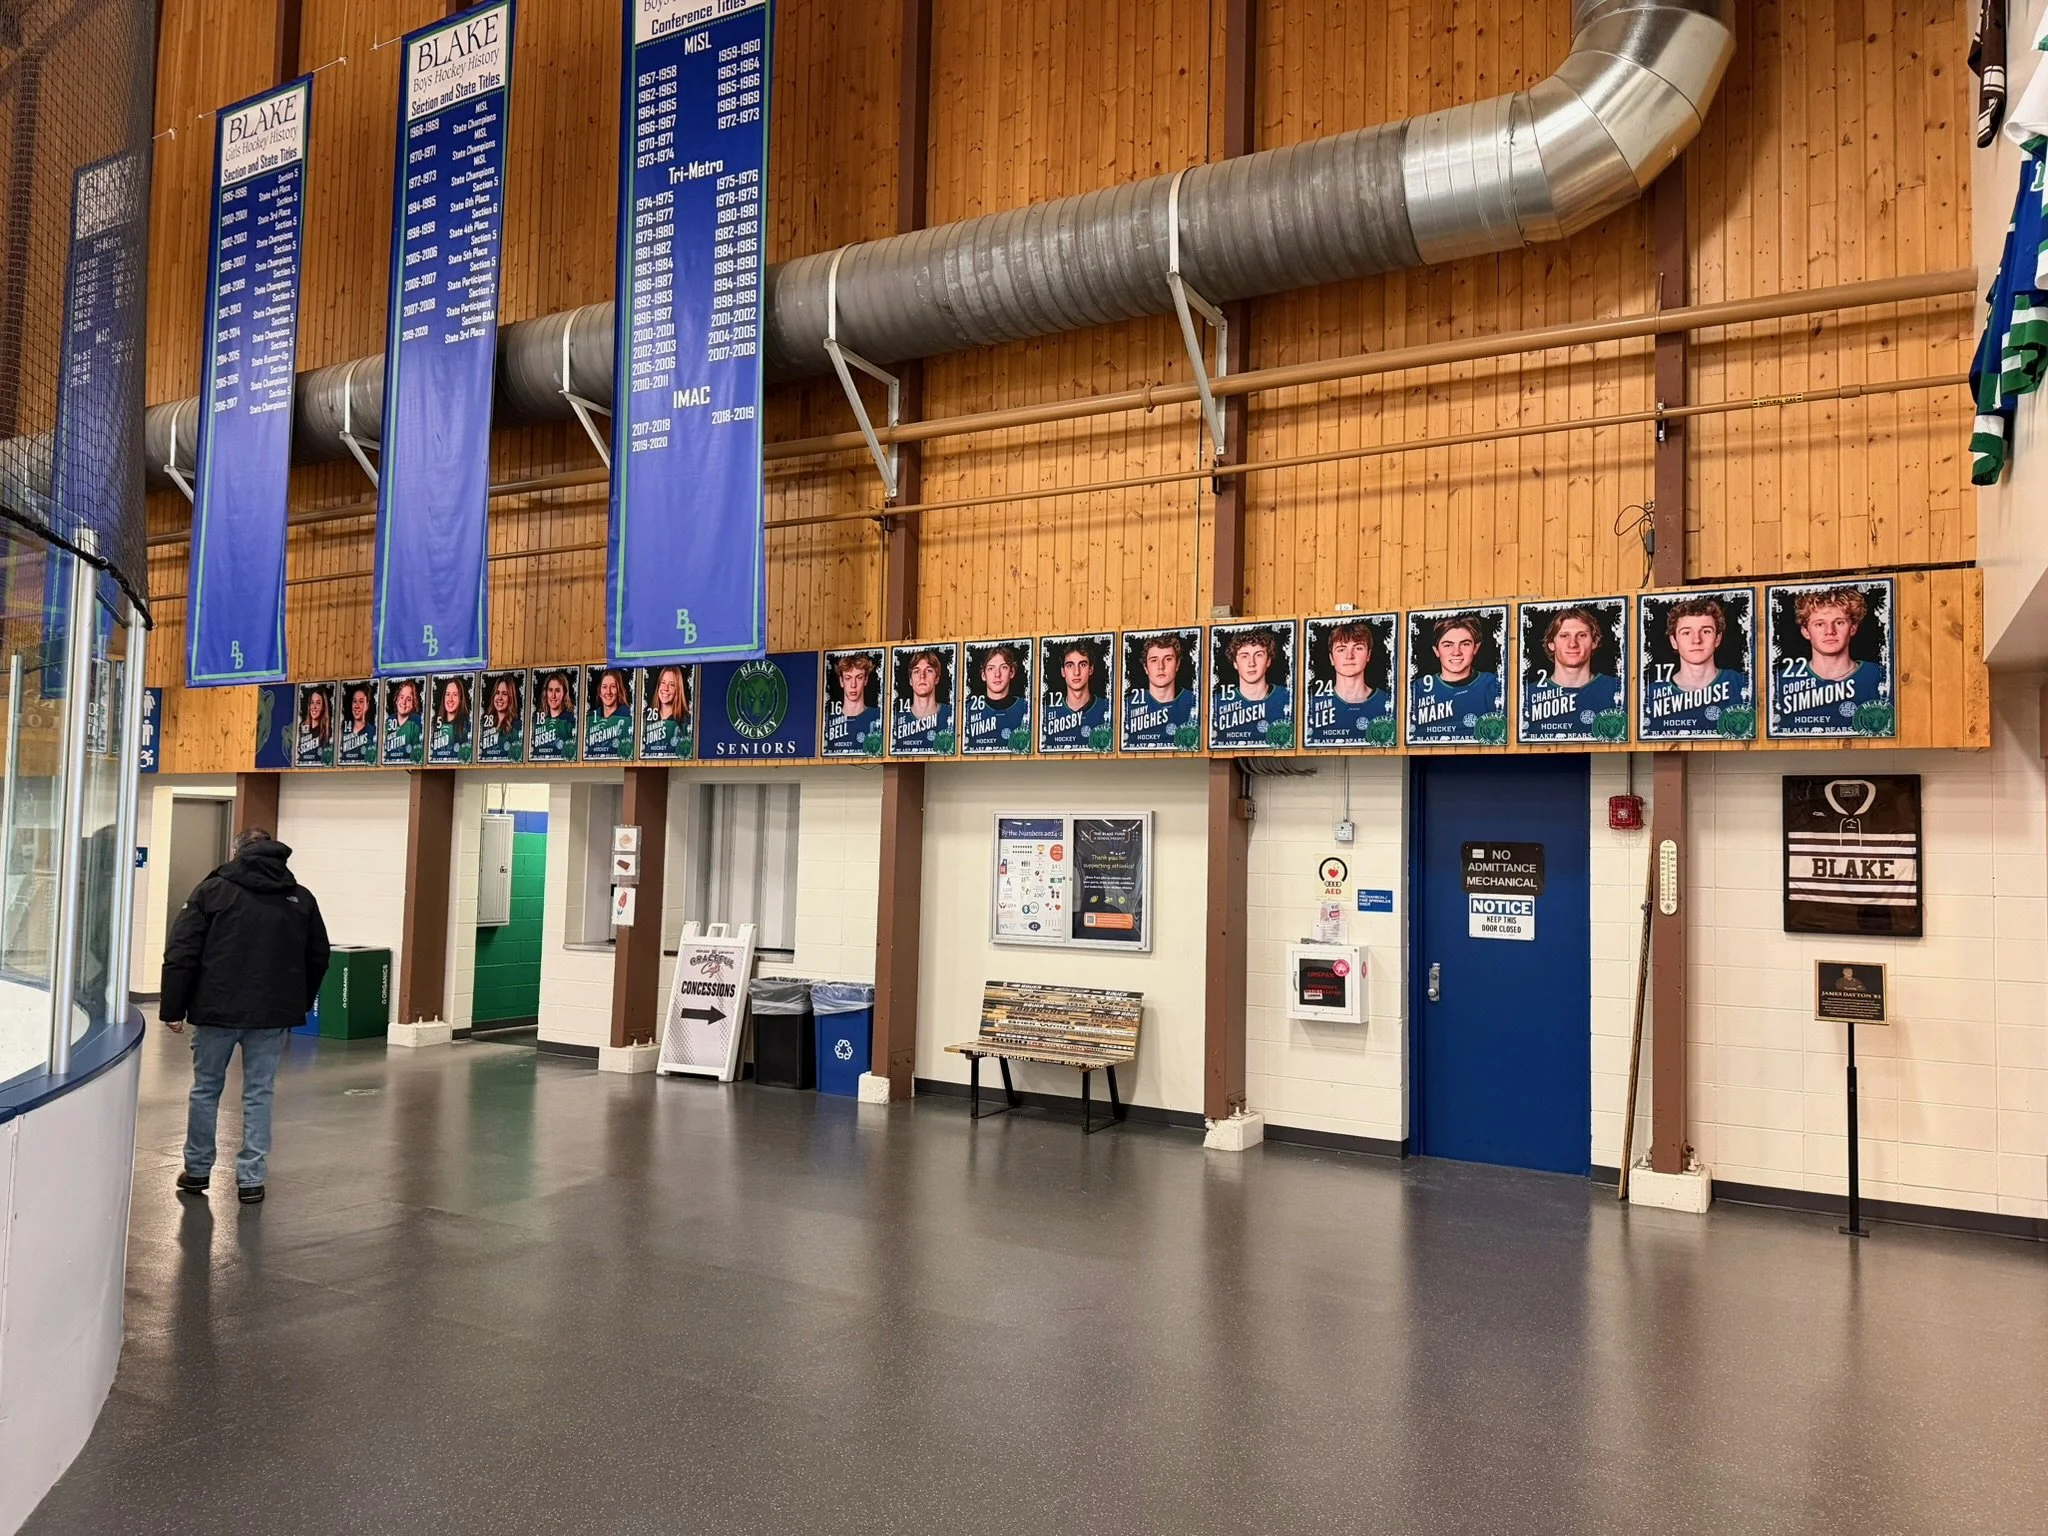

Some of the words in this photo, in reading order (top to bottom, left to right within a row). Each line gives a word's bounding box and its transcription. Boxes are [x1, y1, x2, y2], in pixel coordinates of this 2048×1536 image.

[651, 5, 713, 35] Conference
[717, 0, 747, 14] Titles
[417, 13, 499, 74] BLAKE
[684, 31, 712, 55] MISL
[718, 38, 761, 63] 1959-1960
[413, 74, 433, 93] Boys
[434, 62, 467, 84] Hockey
[468, 48, 500, 72] History
[638, 65, 677, 88] 1957-1958
[717, 57, 760, 81] 1963-1964
[411, 97, 439, 117] Section
[440, 86, 454, 106] and
[455, 81, 477, 99] State
[478, 72, 501, 91] Titles
[638, 81, 677, 104] 1962-1963
[717, 73, 760, 97] 1965-1966
[638, 98, 677, 120] 1964-1965
[717, 90, 760, 113] 1968-1969
[229, 95, 297, 145] BLAKE
[637, 114, 676, 137] 1966-1967
[718, 107, 760, 130] 1972-1973
[225, 144, 241, 162] Girls
[242, 136, 269, 155] Hockey
[269, 126, 298, 145] History
[637, 131, 674, 153] 1970-1971
[223, 165, 247, 183] Section
[247, 157, 259, 174] and
[260, 154, 278, 169] State
[280, 146, 297, 163] Titles
[409, 144, 437, 165] 1970-1971
[637, 147, 675, 169] 1973-1974
[408, 169, 437, 190] 1972-1973
[668, 160, 724, 185] Tri-Metro
[716, 169, 759, 191] 1975-1976
[472, 180, 493, 193] Section
[493, 176, 499, 186] 5
[636, 190, 674, 212] 1974-1975
[716, 186, 758, 208] 1978-1979
[471, 207, 492, 219] Section
[636, 207, 674, 228] 1976-1977
[717, 203, 758, 224] 1980-1981
[635, 223, 674, 245] 1979-1980
[715, 220, 758, 241] 1982-1983
[635, 240, 672, 261] 1981-1982
[714, 238, 757, 259] 1984-1985
[469, 260, 491, 272] Section
[491, 256, 496, 267] 5
[635, 257, 674, 277] 1983-1984
[714, 255, 757, 276] 1989-1990
[634, 273, 674, 293] 1986-1987
[714, 272, 757, 293] 1994-1995
[713, 289, 757, 310] 1998-1999
[711, 307, 757, 327] 2001-2002
[633, 322, 675, 343] 2000-2001
[708, 324, 757, 345] 2004-2005
[633, 339, 677, 360] 2002-2003
[708, 341, 756, 362] 2007-2008
[632, 356, 676, 376] 2005-2006
[632, 373, 669, 393] 2010-2011
[673, 385, 711, 409] IMAC
[711, 406, 755, 425] 2018-2019
[632, 418, 671, 437] 2017-2018
[632, 436, 668, 453] 2019-2020
[740, 661, 776, 677] BLAKE
[1654, 663, 1675, 683] 17
[1782, 657, 1808, 678] 22
[1315, 679, 1334, 697] 24
[1423, 674, 1434, 693] 9
[1536, 669, 1548, 688] 2
[1783, 677, 1817, 695] COOPER
[1048, 692, 1063, 707] 12
[1130, 688, 1146, 704] 21
[1220, 684, 1236, 701] 15
[1418, 695, 1436, 708] JACK
[1531, 687, 1564, 703] CHARLIE
[1652, 685, 1673, 700] JACK
[1652, 681, 1730, 718] NEWHOUSE
[1783, 679, 1855, 714] SIMMONS
[830, 700, 843, 715] 16
[898, 698, 911, 713] 14
[970, 695, 985, 711] 26
[1219, 700, 1243, 715] CHAYCE
[1315, 699, 1333, 712] RYAN
[1418, 700, 1454, 725] MARK
[1531, 694, 1577, 722] MOORE
[436, 716, 442, 728] 5
[483, 714, 494, 727] 28
[536, 711, 546, 724] 18
[646, 707, 659, 721] 26
[970, 712, 982, 724] MAX
[1048, 711, 1057, 721] ELI
[1048, 711, 1083, 736] CROSBY
[1130, 708, 1169, 733] HUGHES
[1219, 702, 1266, 731] CLAUSEN
[1315, 705, 1336, 728] LEE
[1663, 719, 1697, 727] HOCKEY
[1794, 715, 1831, 724] HOCKEY
[344, 720, 352, 732] 14
[387, 718, 397, 731] 30
[734, 717, 777, 738] HOCKEY
[828, 723, 849, 741] BELL
[897, 713, 938, 739] ERICKSON
[970, 716, 997, 738] VINAR
[1426, 725, 1457, 733] HOCKEY
[1541, 722, 1573, 730] HOCKEY
[343, 735, 368, 753] WILLIAMS
[482, 732, 499, 749] BLEW
[646, 726, 666, 745] JONES
[716, 740, 796, 755] SENIORS
[1492, 850, 1511, 860] NO
[1467, 862, 1537, 873] ADMITTANCE
[1811, 857, 1895, 880] BLAKE
[1466, 876, 1537, 888] MECHANICAL
[1472, 899, 1532, 915] NOTICE
[1481, 924, 1498, 933] DOOR
[1498, 925, 1522, 934] CLOSED
[1486, 915, 1502, 924] KEEP
[681, 980, 736, 998] CONCESSIONS
